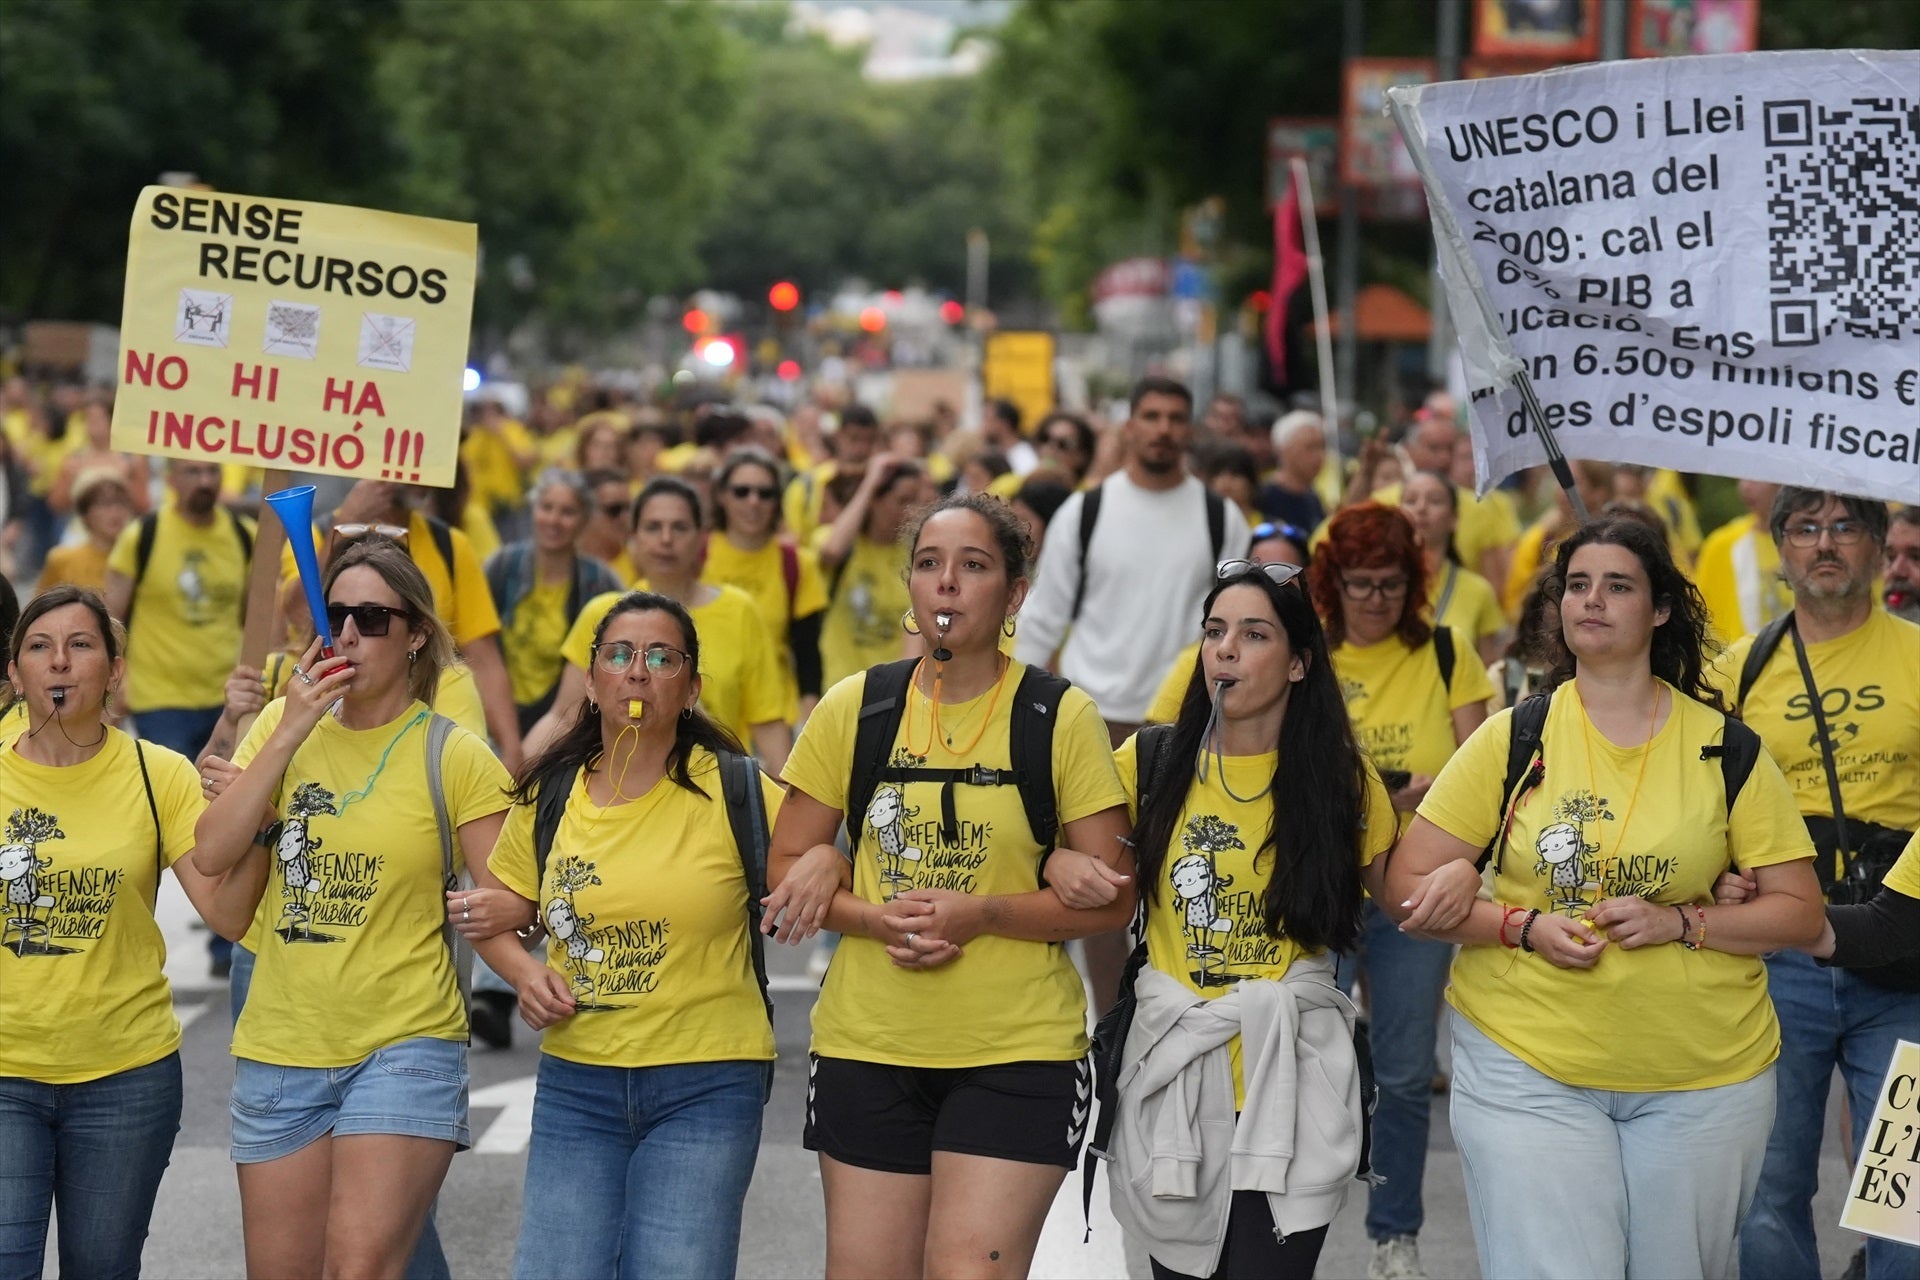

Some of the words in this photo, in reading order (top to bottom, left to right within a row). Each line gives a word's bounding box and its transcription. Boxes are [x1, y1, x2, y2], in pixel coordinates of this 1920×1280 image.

[1443, 104, 1619, 163] UNESCO
[1636, 102, 1645, 139] i
[1664, 94, 1744, 137] Llei
[1467, 169, 1636, 215] catalana
[1652, 153, 1719, 195] del
[150, 192, 303, 244] SENSE
[1473, 219, 1587, 265] 2009:
[1601, 215, 1664, 257] cal
[1676, 210, 1714, 250] el
[199, 242, 448, 304] RECURSOS
[1577, 273, 1652, 310] PIB
[1669, 277, 1694, 309] a
[1499, 303, 1655, 338] ucació.
[1672, 325, 1756, 360] Ens
[124, 349, 189, 391] NO
[230, 362, 279, 402] HI
[322, 377, 386, 417] HA
[1573, 343, 1695, 380] 6.500
[1894, 369, 1919, 406] €
[147, 410, 365, 471] INCLUSIÓ
[380, 426, 425, 482] !!!
[1506, 392, 1593, 439] des
[1608, 391, 1793, 447] d'espoli
[1808, 412, 1920, 465] fiscal
[1783, 684, 1886, 721] SOS
[38, 866, 117, 896] DEFENSEM
[308, 852, 377, 883] DEFENSEM
[1584, 854, 1670, 883] DEFENSEM
[1218, 889, 1265, 919] DEFEN
[1887, 1073, 1920, 1115] C
[1854, 1157, 1911, 1210] ÉS
